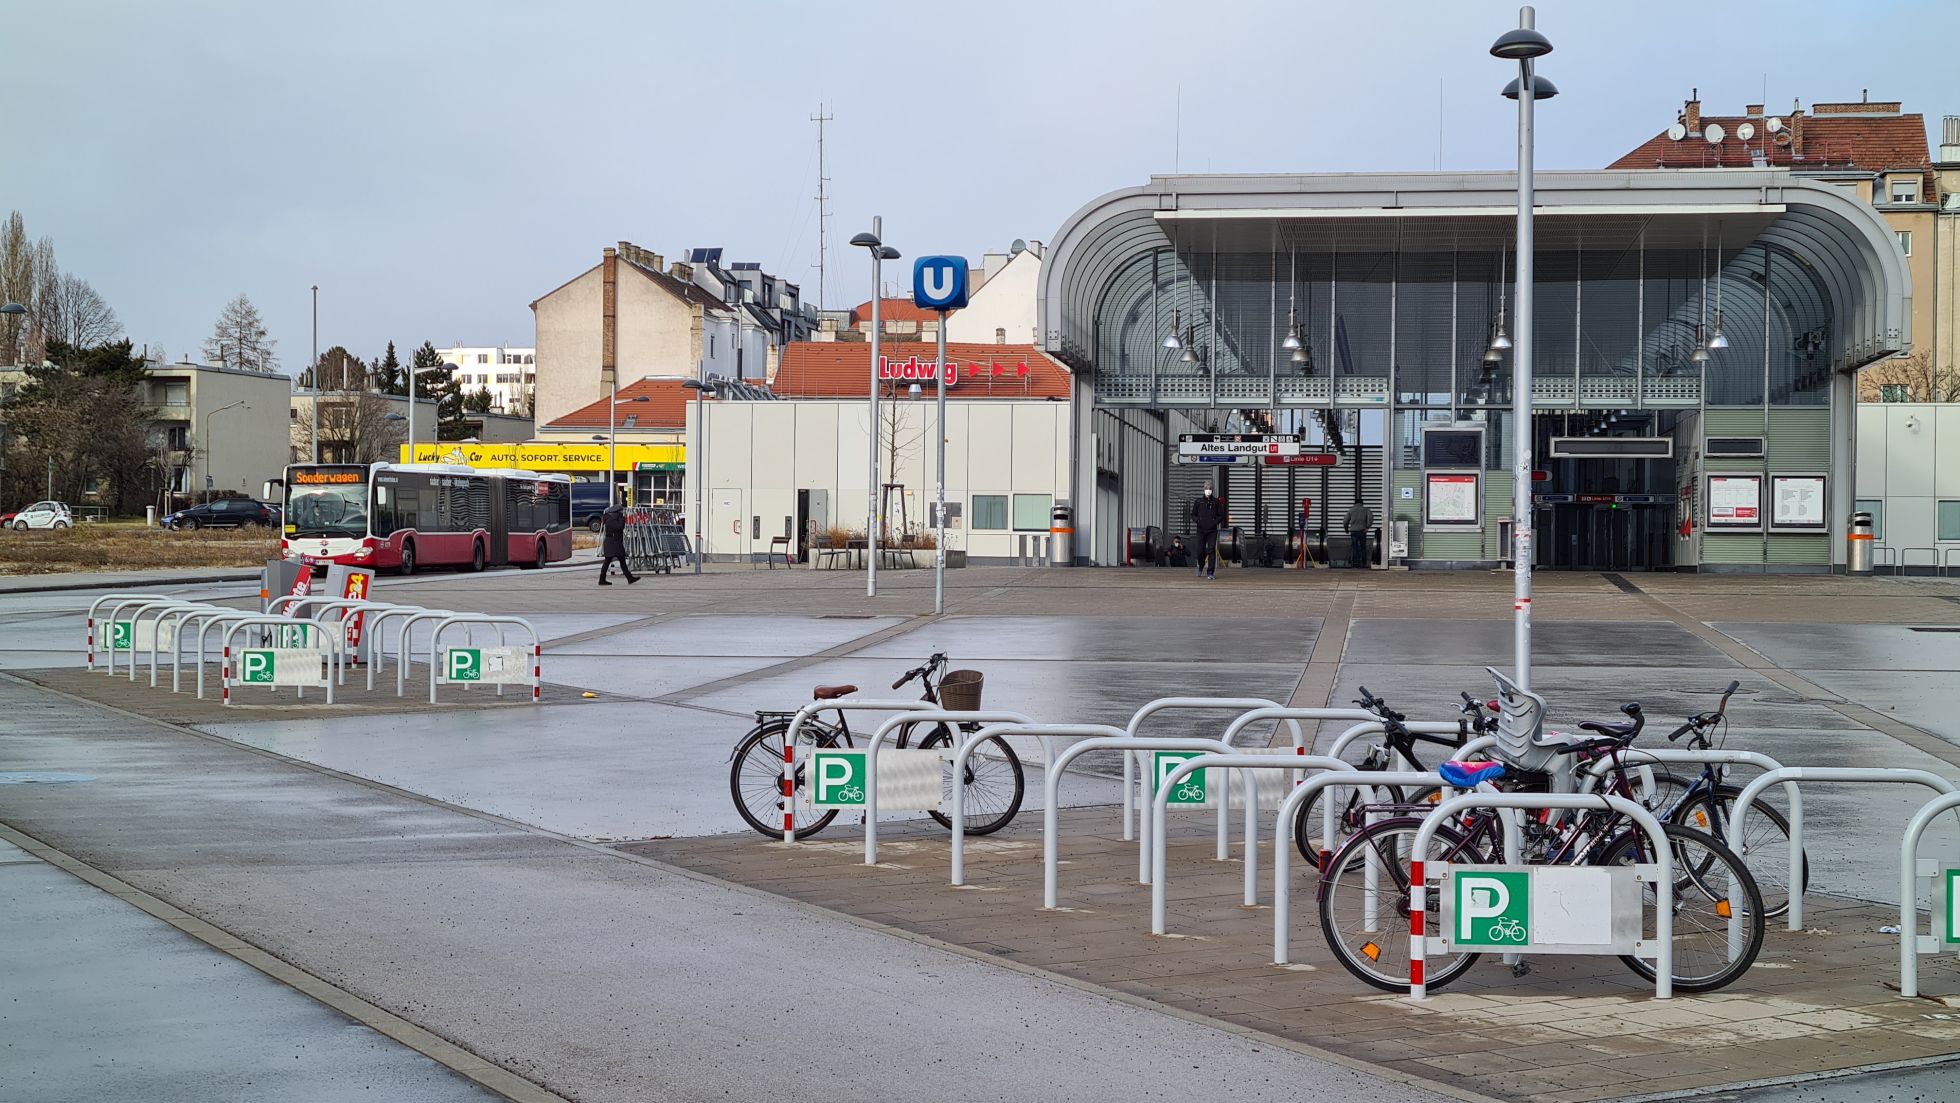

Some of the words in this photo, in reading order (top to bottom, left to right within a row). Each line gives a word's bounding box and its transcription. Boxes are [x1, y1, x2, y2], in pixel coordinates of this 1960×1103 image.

[923, 267, 953, 300] U
[879, 356, 958, 385] Ludwg
[418, 453, 440, 463] Lucky
[469, 453, 483, 462] Car
[490, 454, 518, 462] AUTO.
[521, 454, 560, 462] SOFORT.
[563, 454, 604, 462] SERVICE.
[1200, 443, 1225, 452] Altes
[1227, 443, 1268, 454] Landgut
[296, 472, 359, 483] Sonderwagen
[105, 624, 125, 647] P
[245, 653, 267, 680] P
[452, 651, 473, 678] P
[819, 757, 853, 801] P
[1461, 877, 1509, 940] P
